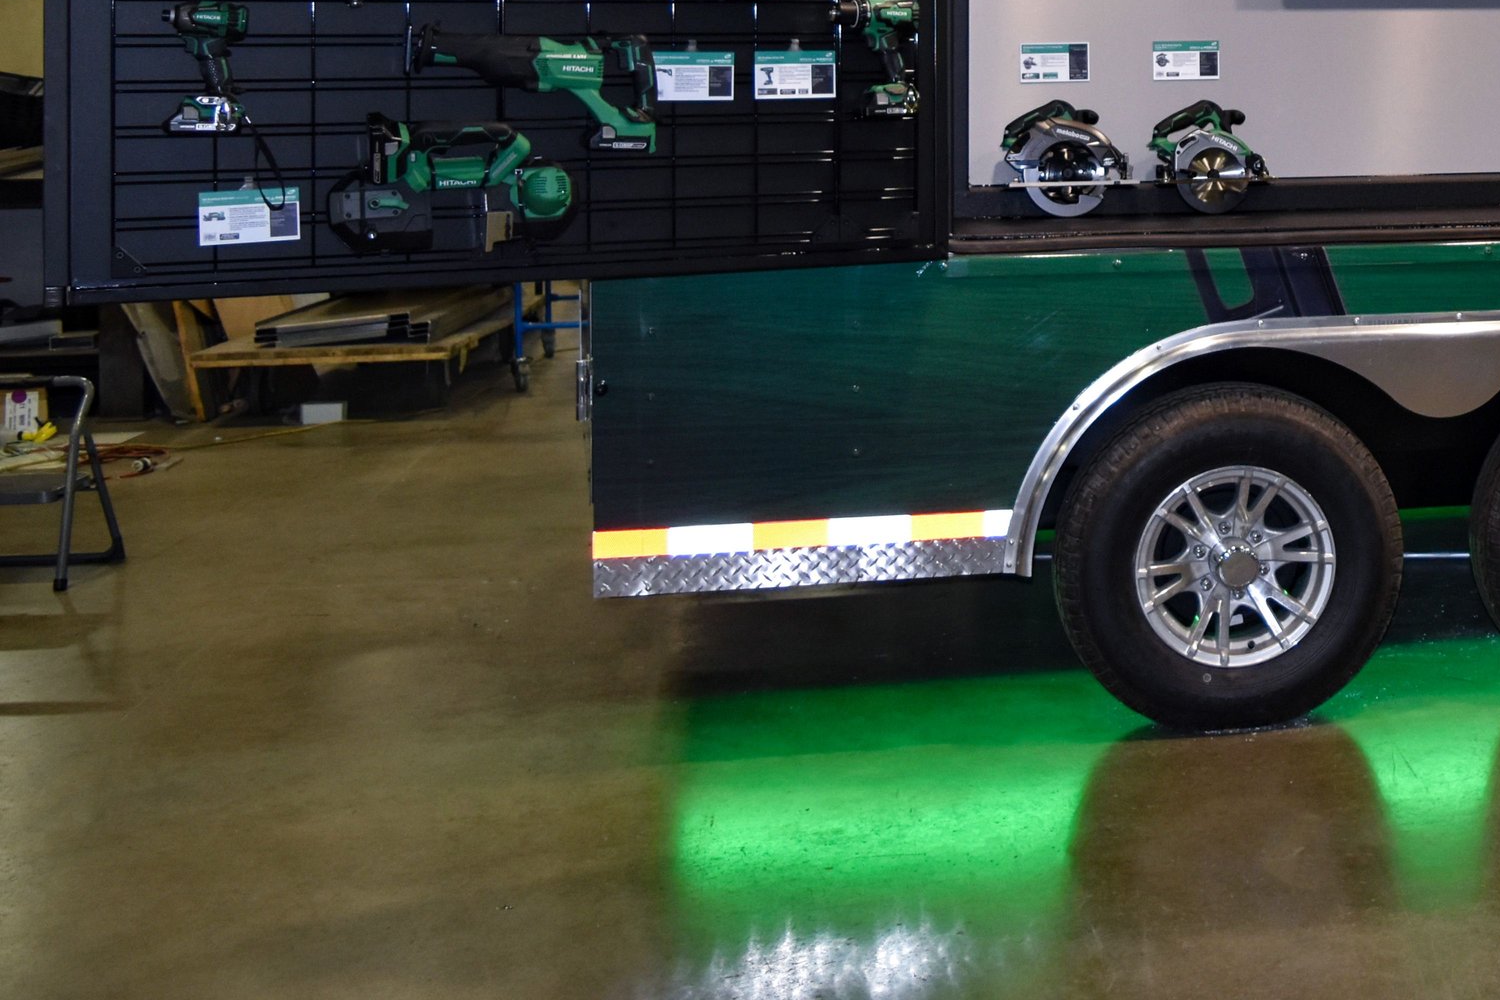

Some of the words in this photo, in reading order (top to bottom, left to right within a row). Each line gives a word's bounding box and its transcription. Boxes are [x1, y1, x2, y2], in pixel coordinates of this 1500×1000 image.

[196, 12, 222, 22] HITACHI
[562, 64, 595, 73] HITACHI
[1211, 135, 1239, 152] HITACHI
